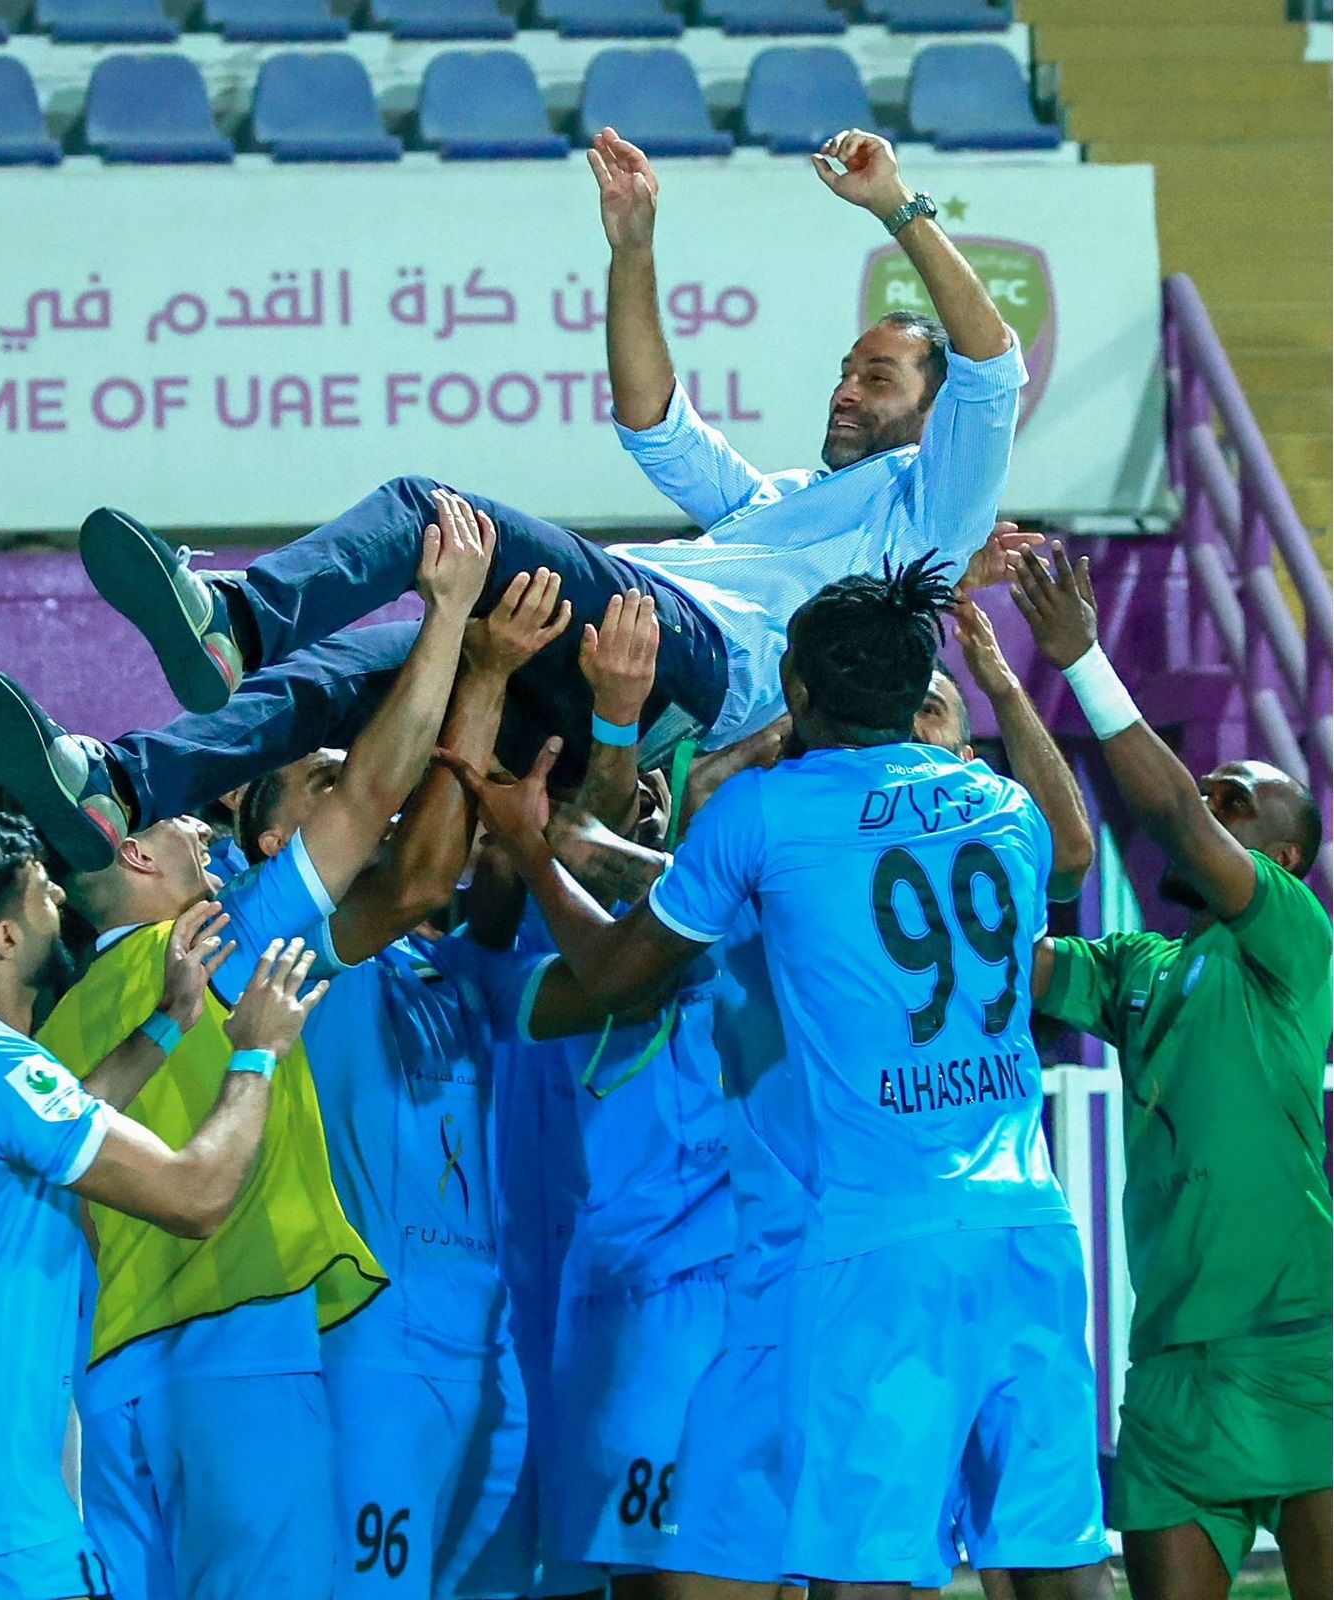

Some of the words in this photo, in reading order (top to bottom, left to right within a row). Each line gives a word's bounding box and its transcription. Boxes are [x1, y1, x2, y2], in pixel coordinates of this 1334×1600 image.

[144, 267, 352, 344] القدم
[388, 266, 517, 340] كرة
[552, 271, 760, 337] مون
[91, 377, 190, 431] OF
[214, 374, 362, 431] UAE
[385, 369, 762, 429] FOOTLL
[870, 839, 1019, 1047] 99
[354, 1501, 411, 1580] 96
